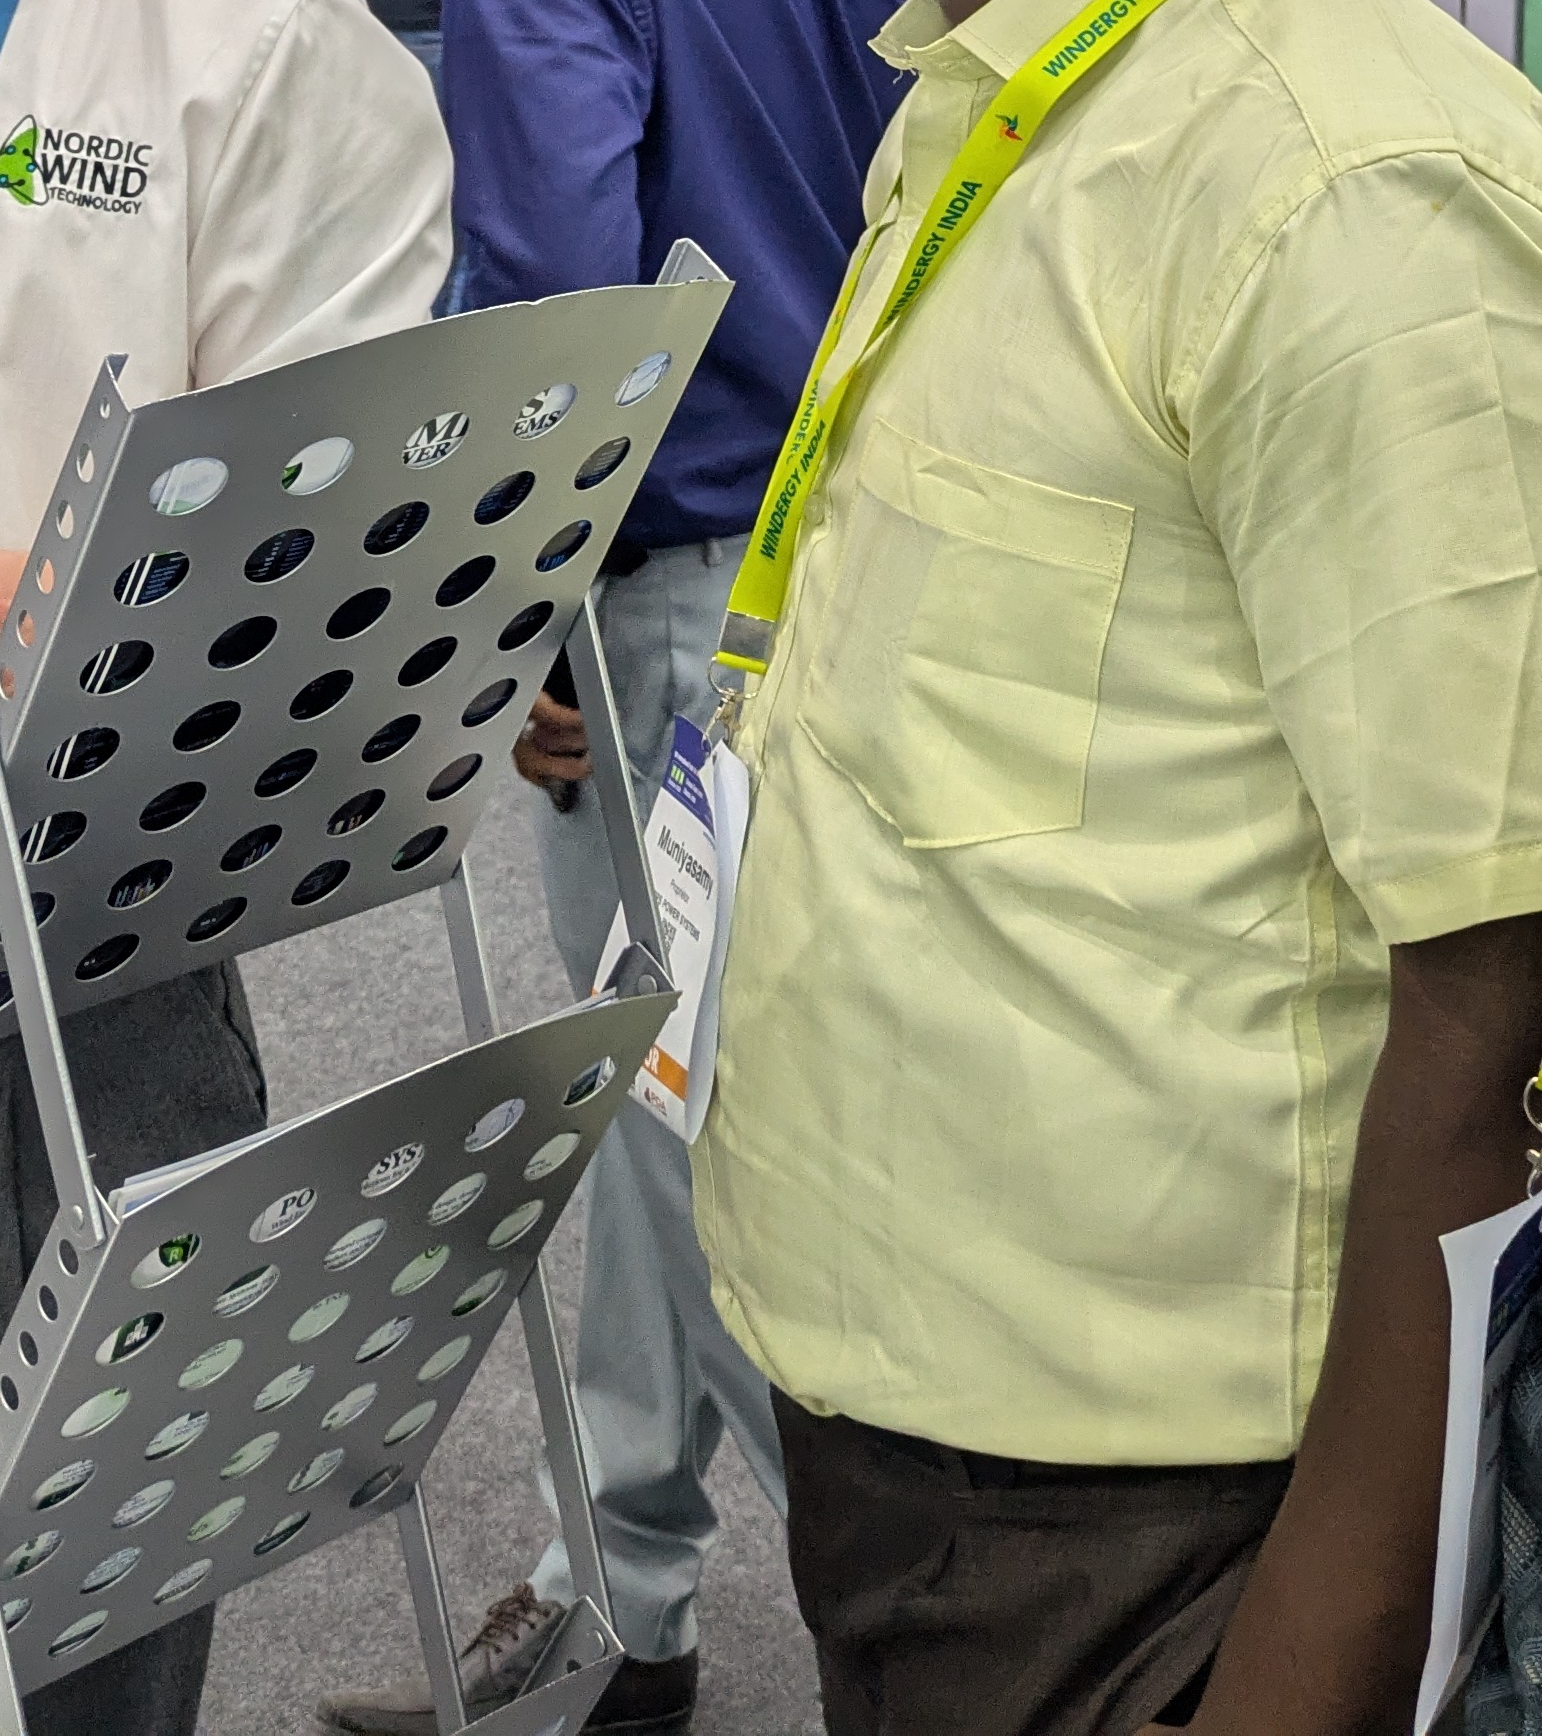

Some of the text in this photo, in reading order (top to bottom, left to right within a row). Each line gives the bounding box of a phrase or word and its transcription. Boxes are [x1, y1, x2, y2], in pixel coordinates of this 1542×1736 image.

[43, 128, 153, 167] NORDIC
[41, 153, 148, 198] WIND
[49, 186, 143, 215] TECHNOLOGY
[937, 181, 983, 230] INDIA
[760, 419, 827, 560] WINDERGY INDIA
[657, 824, 714, 900] Muniyasamy
[661, 897, 681, 921] POWER
[679, 914, 702, 942] SYSTEMS
